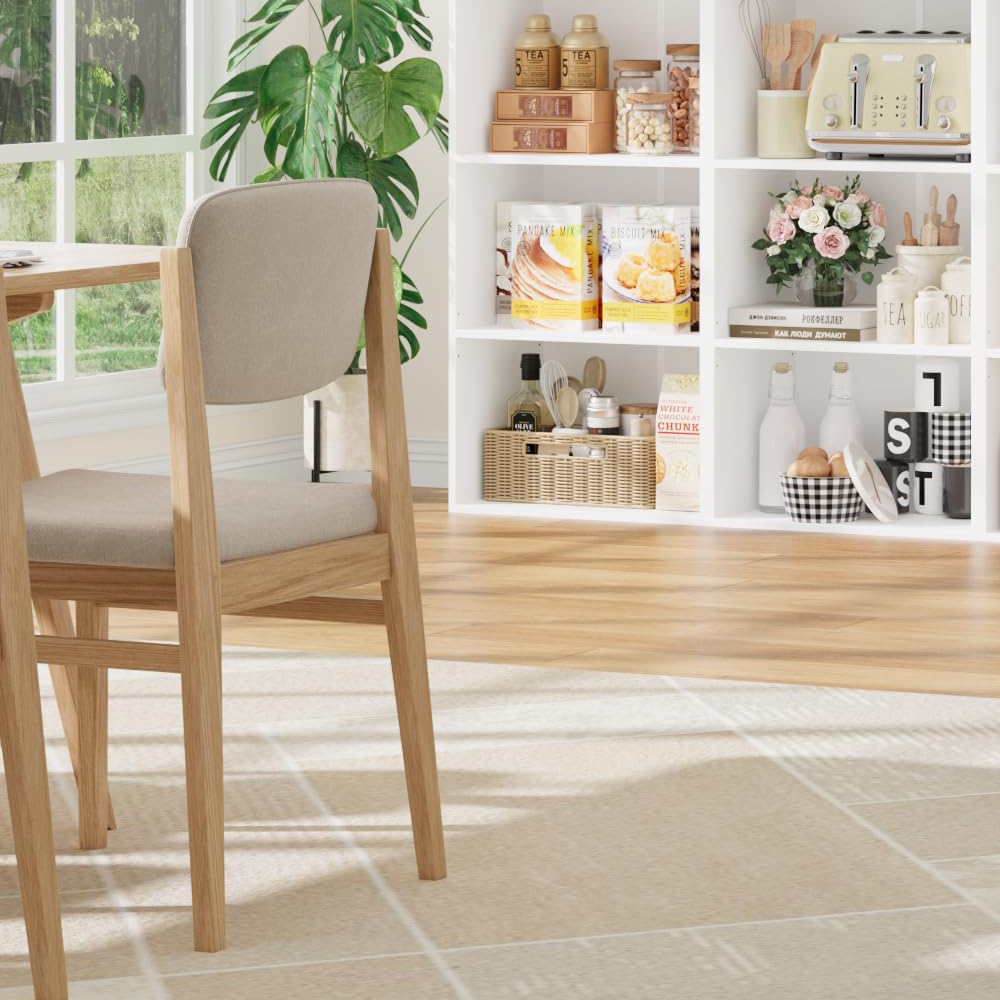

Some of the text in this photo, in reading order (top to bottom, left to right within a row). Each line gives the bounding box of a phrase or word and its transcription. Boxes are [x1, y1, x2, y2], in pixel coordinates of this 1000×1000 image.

[525, 51, 544, 59] TEA
[572, 51, 591, 60] TEA
[515, 58, 522, 76] 5
[562, 58, 568, 77] 5
[517, 224, 575, 237] PANCAKE MIX
[610, 226, 666, 240] BISCUIT MIX
[802, 314, 844, 325] РОКФЕЛЛЕР
[882, 302, 906, 326] TEA
[774, 329, 789, 337] КАК
[790, 330, 813, 338] ЛЮДИ
[814, 331, 847, 339] ДУМАЮТ
[660, 405, 693, 413] WHITE
[657, 421, 699, 431] CHUNK
[886, 417, 911, 455] S
[915, 471, 933, 506] T
